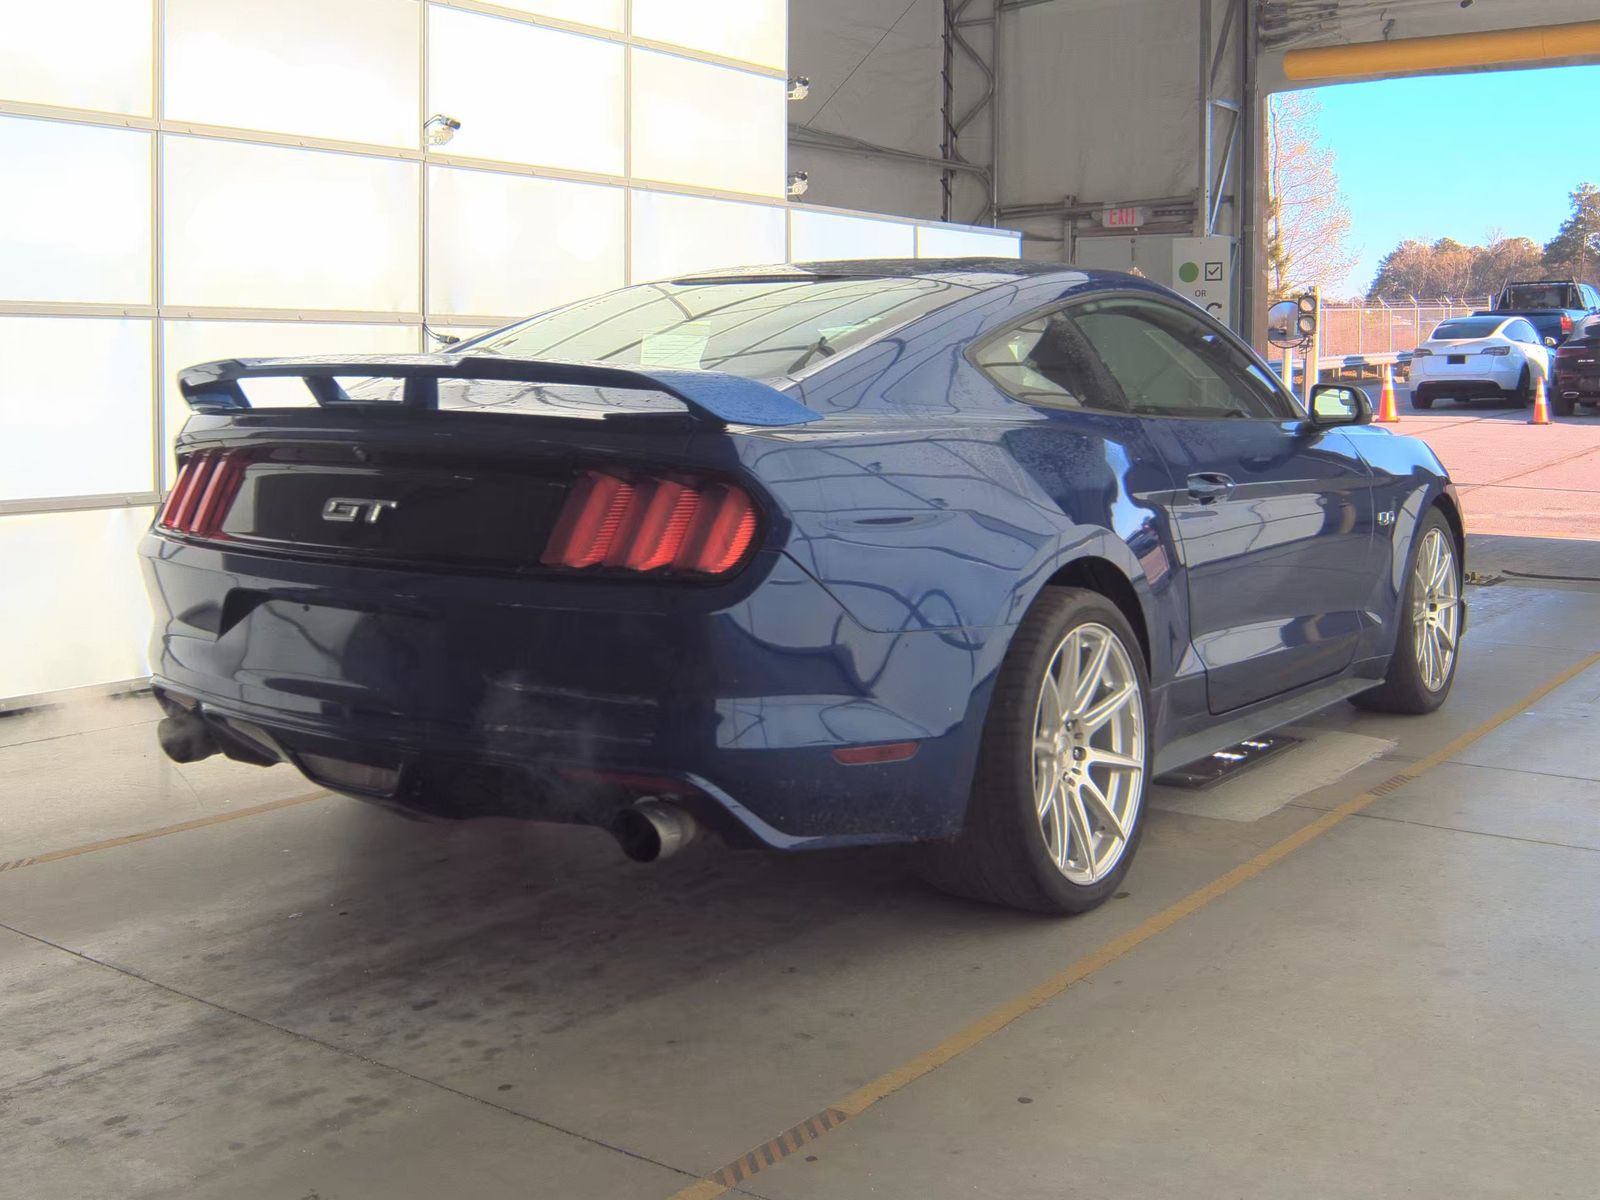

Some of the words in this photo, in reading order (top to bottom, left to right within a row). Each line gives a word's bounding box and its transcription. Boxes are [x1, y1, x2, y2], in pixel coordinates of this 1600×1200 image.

[1108, 207, 1136, 225] EXIT
[1194, 289, 1207, 297] OR
[322, 497, 398, 523] GT
